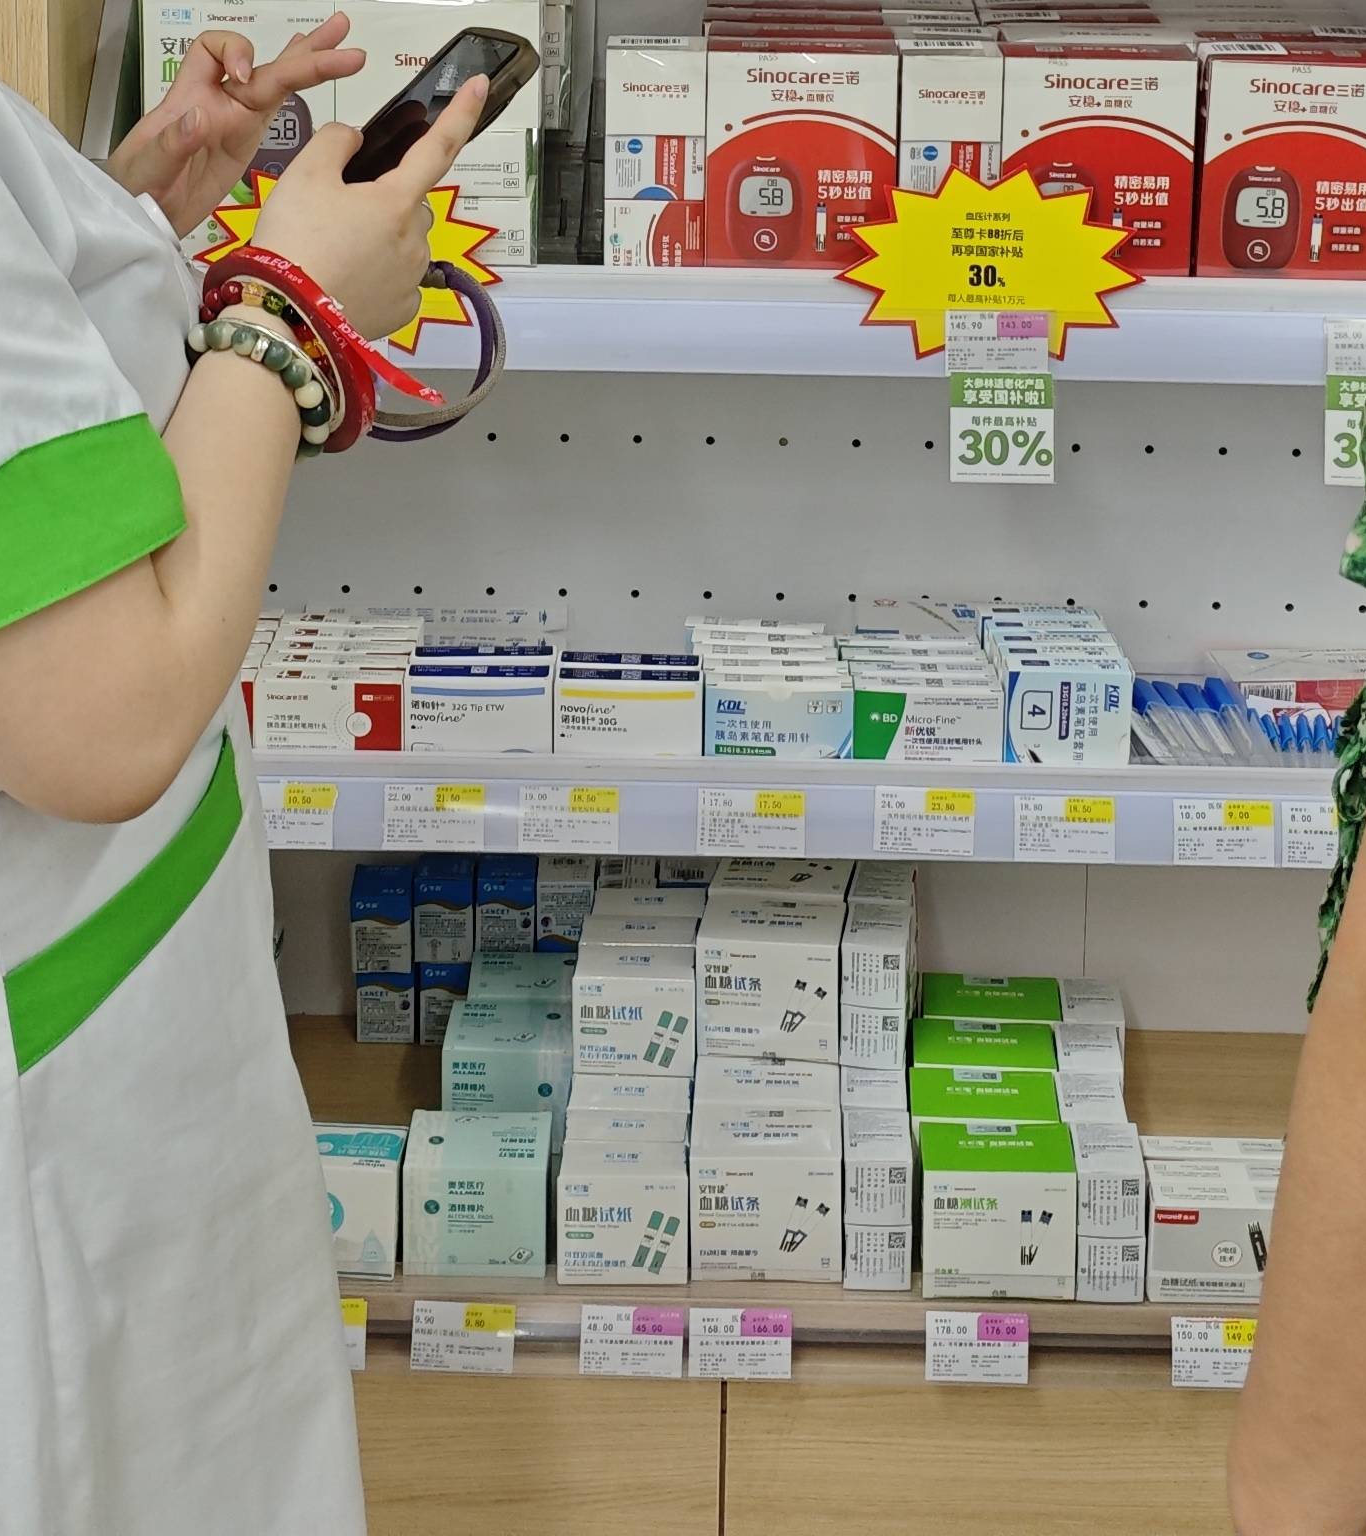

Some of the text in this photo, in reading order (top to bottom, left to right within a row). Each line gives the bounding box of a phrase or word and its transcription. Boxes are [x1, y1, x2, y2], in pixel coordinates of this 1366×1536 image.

[622, 82, 690, 95] Sinocare三诺
[1249, 78, 1365, 98] Sinocare三诺
[817, 170, 873, 185] 精密易用
[818, 185, 872, 201] 5秒出值
[951, 227, 1024, 241] 至尊卡88折后
[951, 244, 1024, 258] 再享国家补贴
[1000, 321, 1032, 329] 143.00
[963, 390, 1045, 405] 享受国补啦!
[958, 429, 1053, 466] 30%
[452, 703, 505, 714] 32G Tip ETW
[717, 700, 744, 714] KDL
[716, 719, 772, 729] 一次性使用
[882, 713, 898, 723] BD
[905, 714, 955, 725] Micro-Fine
[715, 731, 810, 742] 胰岛素笔配套用针
[905, 725, 936, 736] 新优锐
[524, 792, 547, 801] 19.00
[1180, 811, 1250, 820] 10.00 9.00
[705, 976, 762, 992] 血糖试条
[579, 1004, 643, 1022] 血糖试纸
[699, 1195, 761, 1214] 血糖试条
[934, 1196, 998, 1211] 血糖测试条
[565, 1206, 633, 1224] 血糖试纸
[702, 1324, 783, 1334] 168.00 166.00
[935, 1326, 1017, 1335] 178.00 176.00
